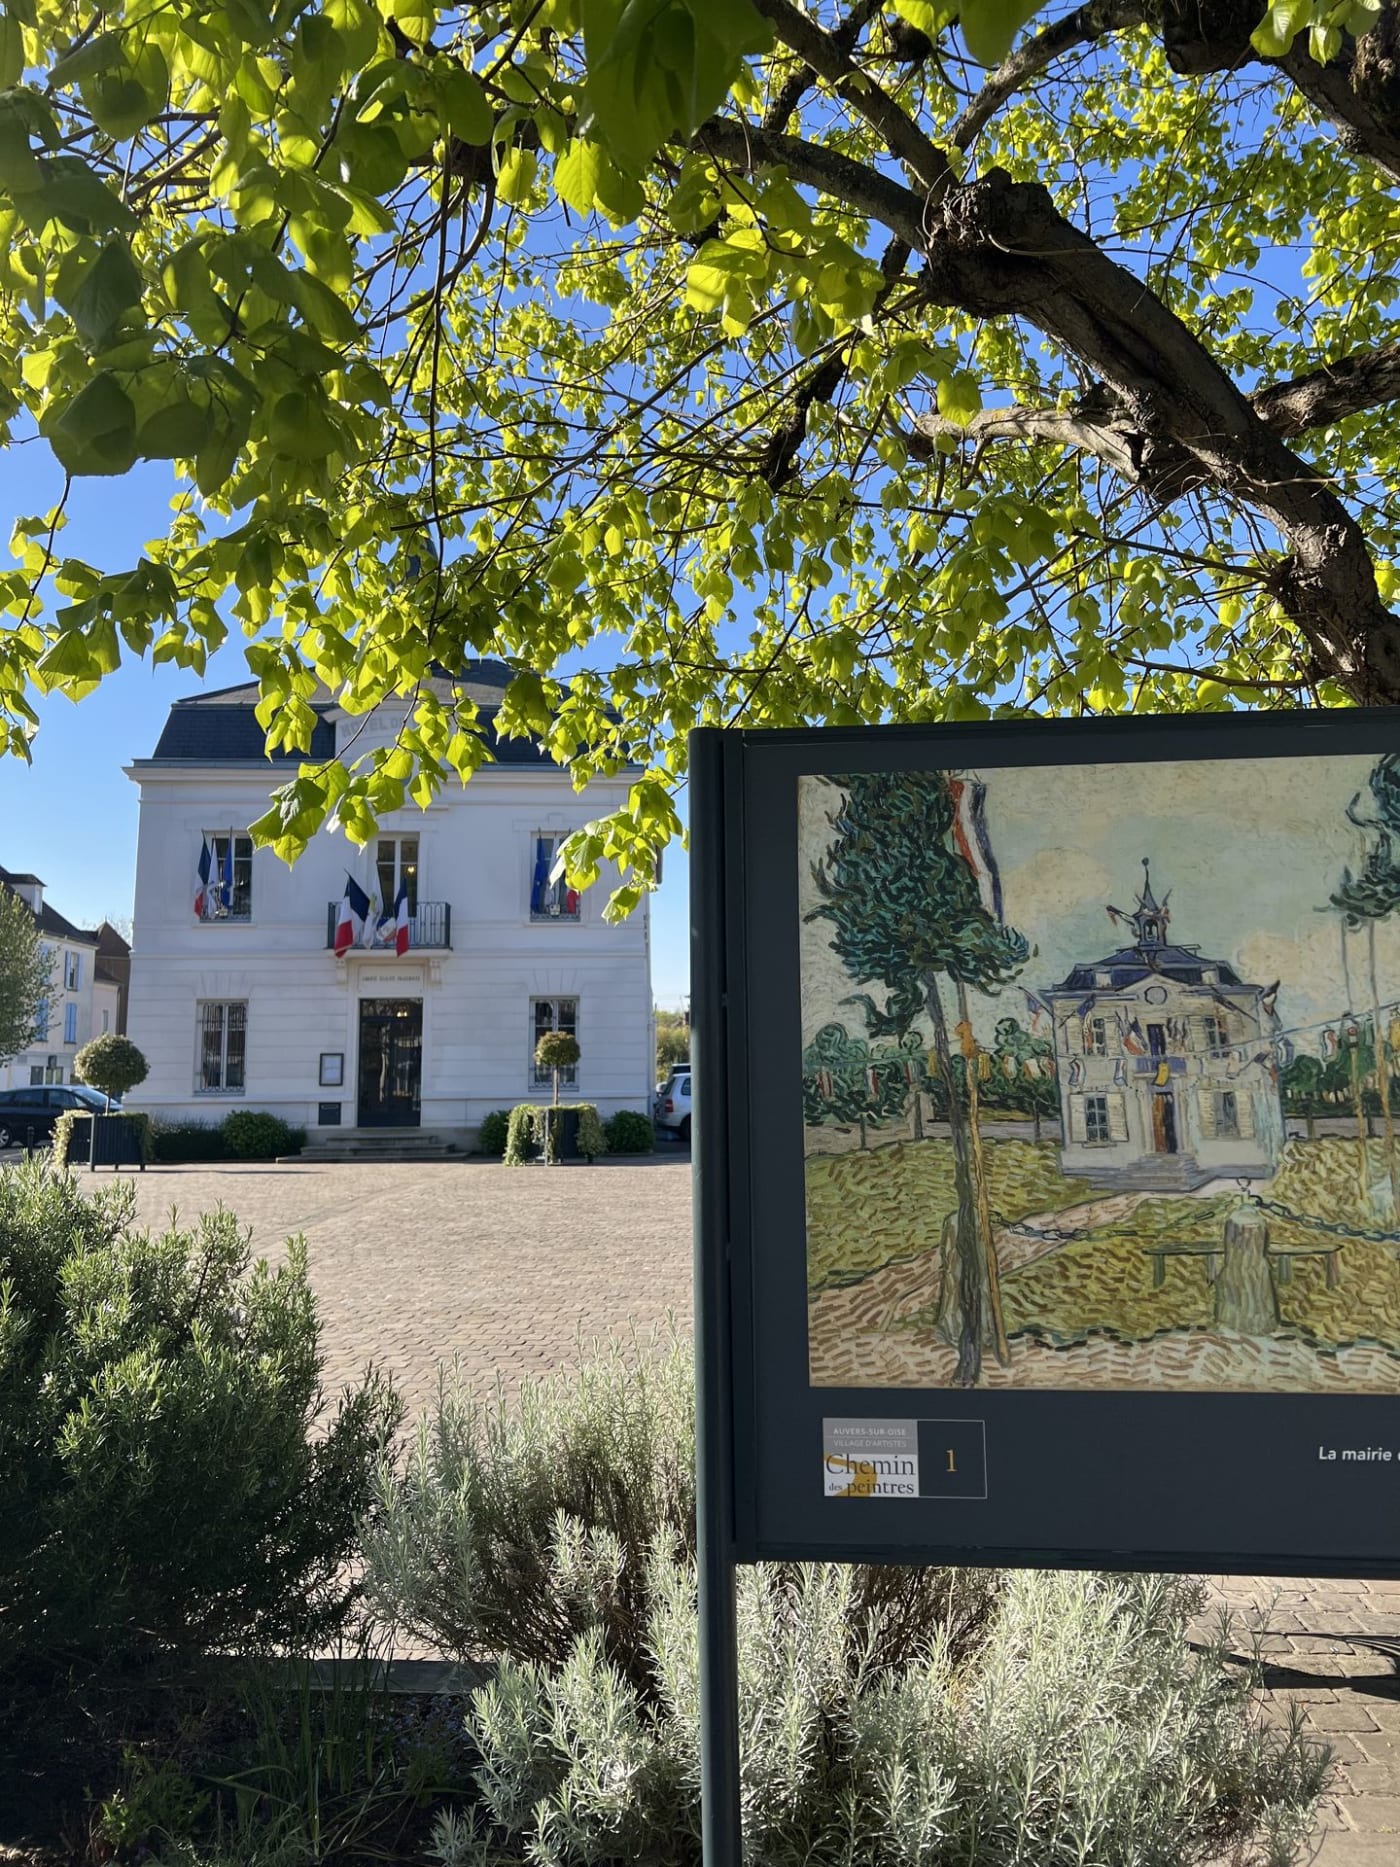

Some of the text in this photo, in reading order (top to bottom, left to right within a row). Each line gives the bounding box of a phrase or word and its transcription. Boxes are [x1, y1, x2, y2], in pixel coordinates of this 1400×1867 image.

[833, 1427, 907, 1436] AUVERS-SUR-OISE
[833, 1439, 907, 1448] VILLAGE D'ARTISTES
[946, 1449, 958, 1472] 1
[1319, 1446, 1337, 1460] La
[1341, 1447, 1393, 1461] mairie
[826, 1452, 916, 1475] Chemin
[829, 1479, 915, 1497] des peintres
